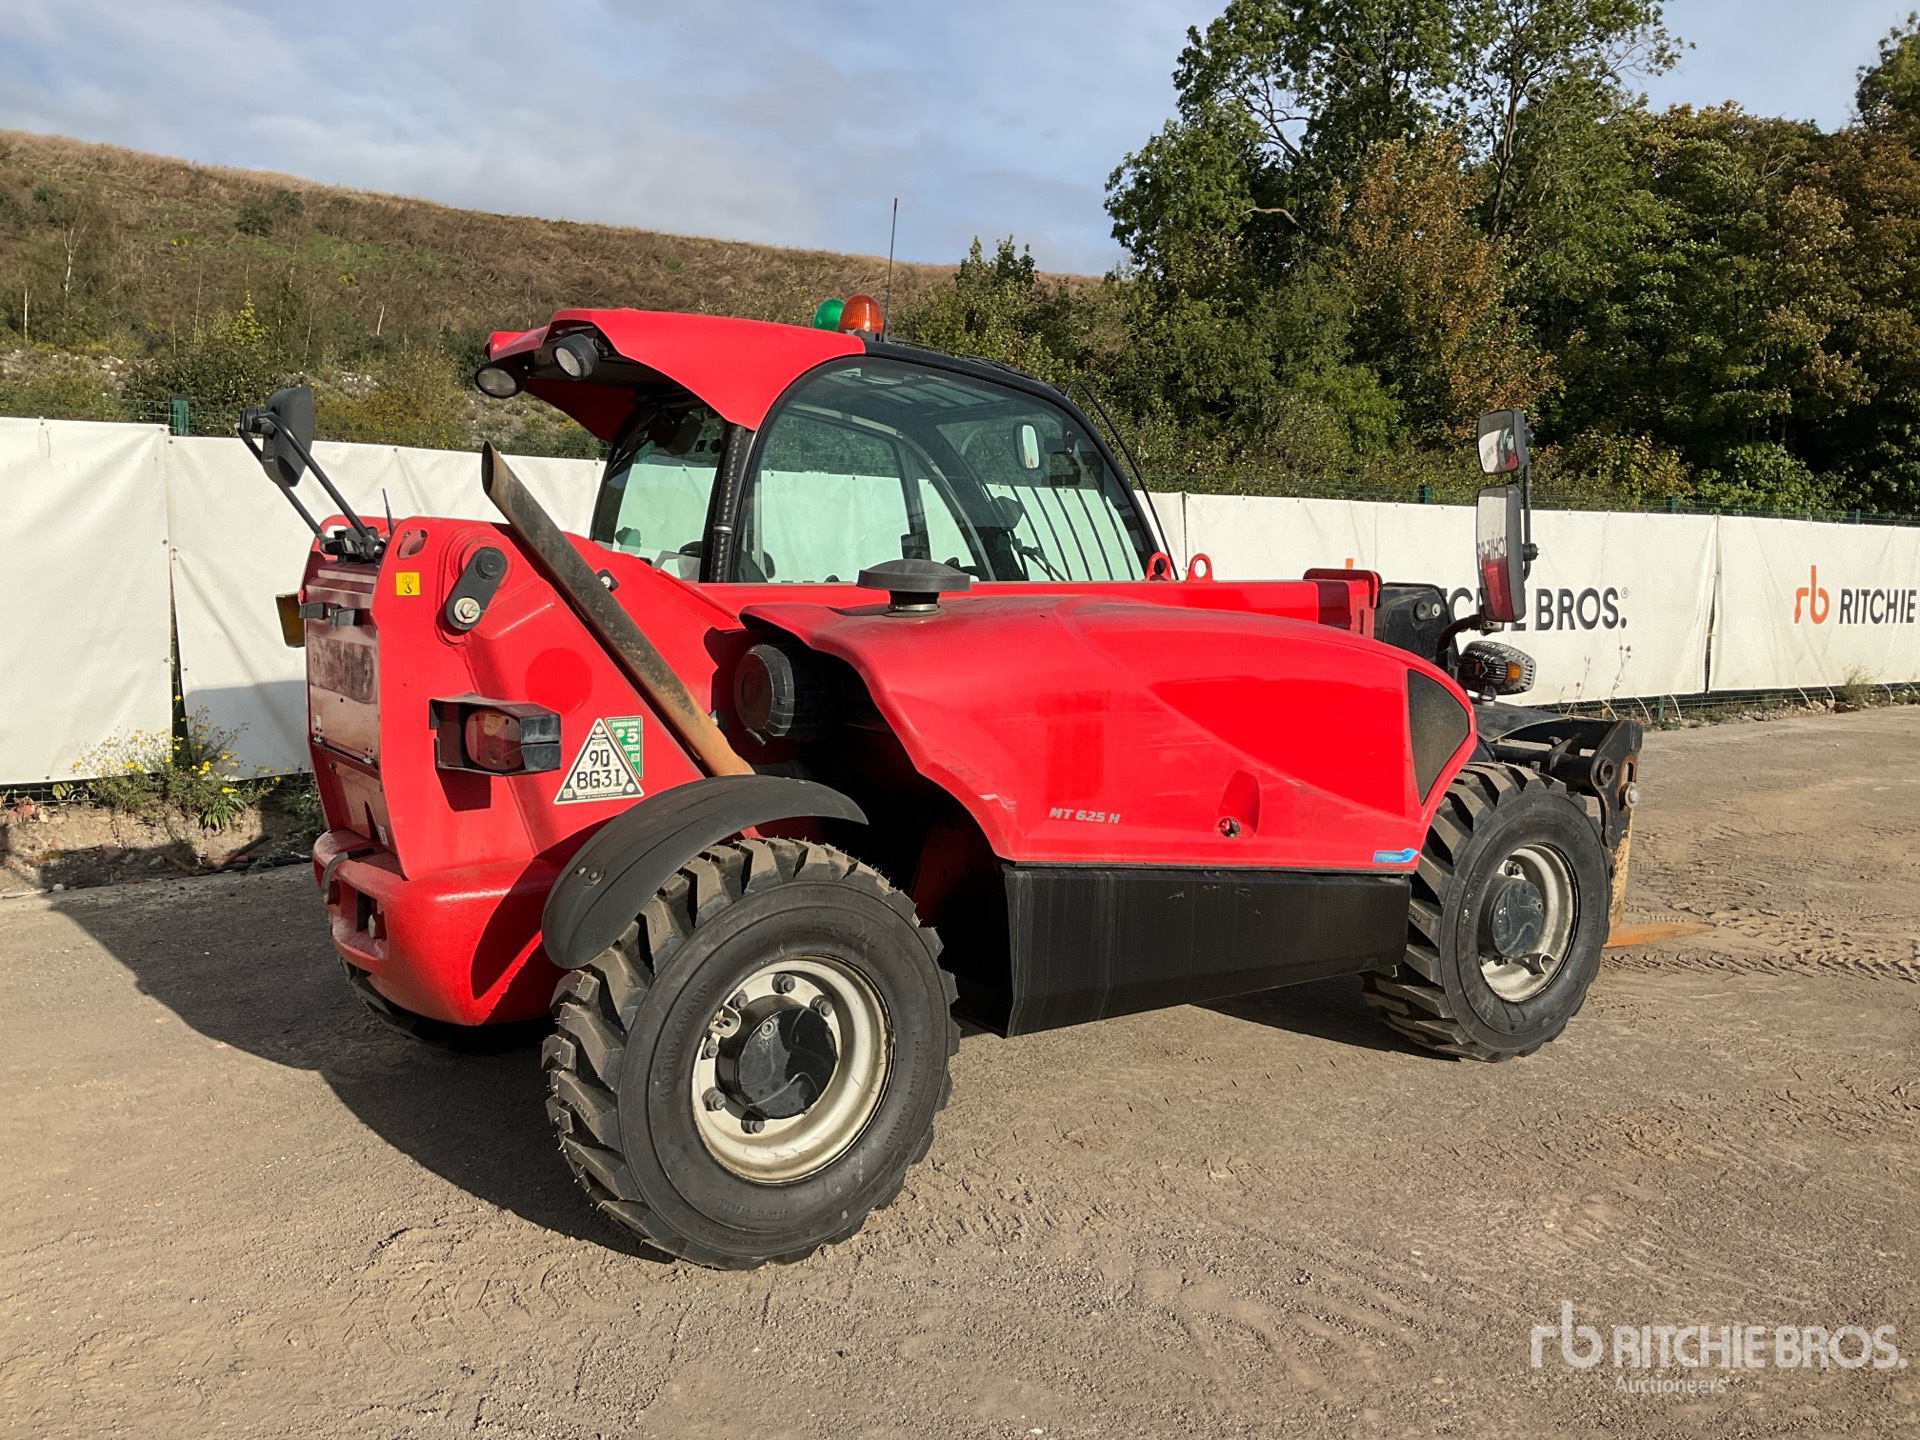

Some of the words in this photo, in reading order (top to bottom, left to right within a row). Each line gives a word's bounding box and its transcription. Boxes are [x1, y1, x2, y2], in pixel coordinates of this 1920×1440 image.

[1839, 588, 1917, 625] RITCHIE
[626, 727, 639, 743] 5
[1049, 807, 1074, 819] MT
[1075, 809, 1105, 822] 625
[1108, 813, 1121, 824] H
